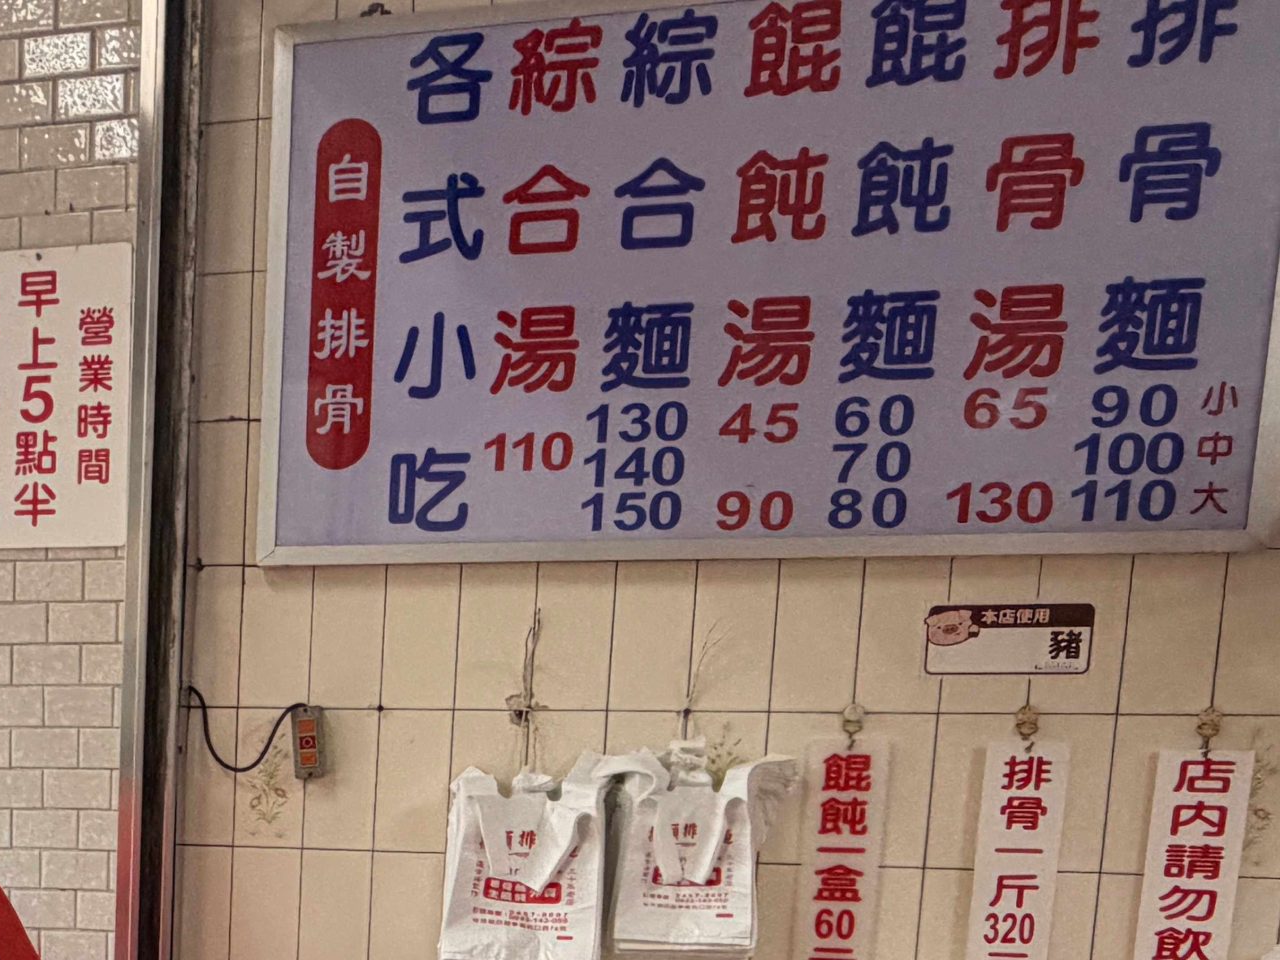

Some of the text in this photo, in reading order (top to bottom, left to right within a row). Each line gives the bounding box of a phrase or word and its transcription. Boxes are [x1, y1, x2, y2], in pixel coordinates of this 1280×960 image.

[489, 17, 603, 394] 綜合湯
[599, 8, 719, 392] 綜合麵
[716, 0, 842, 388] 餛飩湯
[837, 0, 968, 385] 餛飩麵
[962, 0, 1100, 380] 排骨湯
[1092, 0, 1238, 375] 排骨麵
[314, 154, 371, 434] 自製排骨
[388, 32, 493, 532] 各式小吃
[14, 270, 60, 527] 早上5點半
[77, 306, 115, 485] 營業時間
[835, 394, 915, 438] 60
[963, 387, 1049, 430] 65
[1091, 381, 1239, 429] 90 小
[586, 400, 689, 443] 130
[718, 402, 799, 444] 45
[484, 431, 574, 471] 110
[583, 446, 685, 488] 140
[832, 441, 911, 483] 70
[1073, 431, 1233, 476] 100 中
[580, 490, 682, 532] 150
[716, 490, 794, 531] 90
[827, 487, 908, 530] 80
[946, 481, 1054, 524] 130
[1070, 479, 1228, 522] 110 大
[981, 608, 1050, 624] 本店使用
[1048, 629, 1083, 660] 豬
